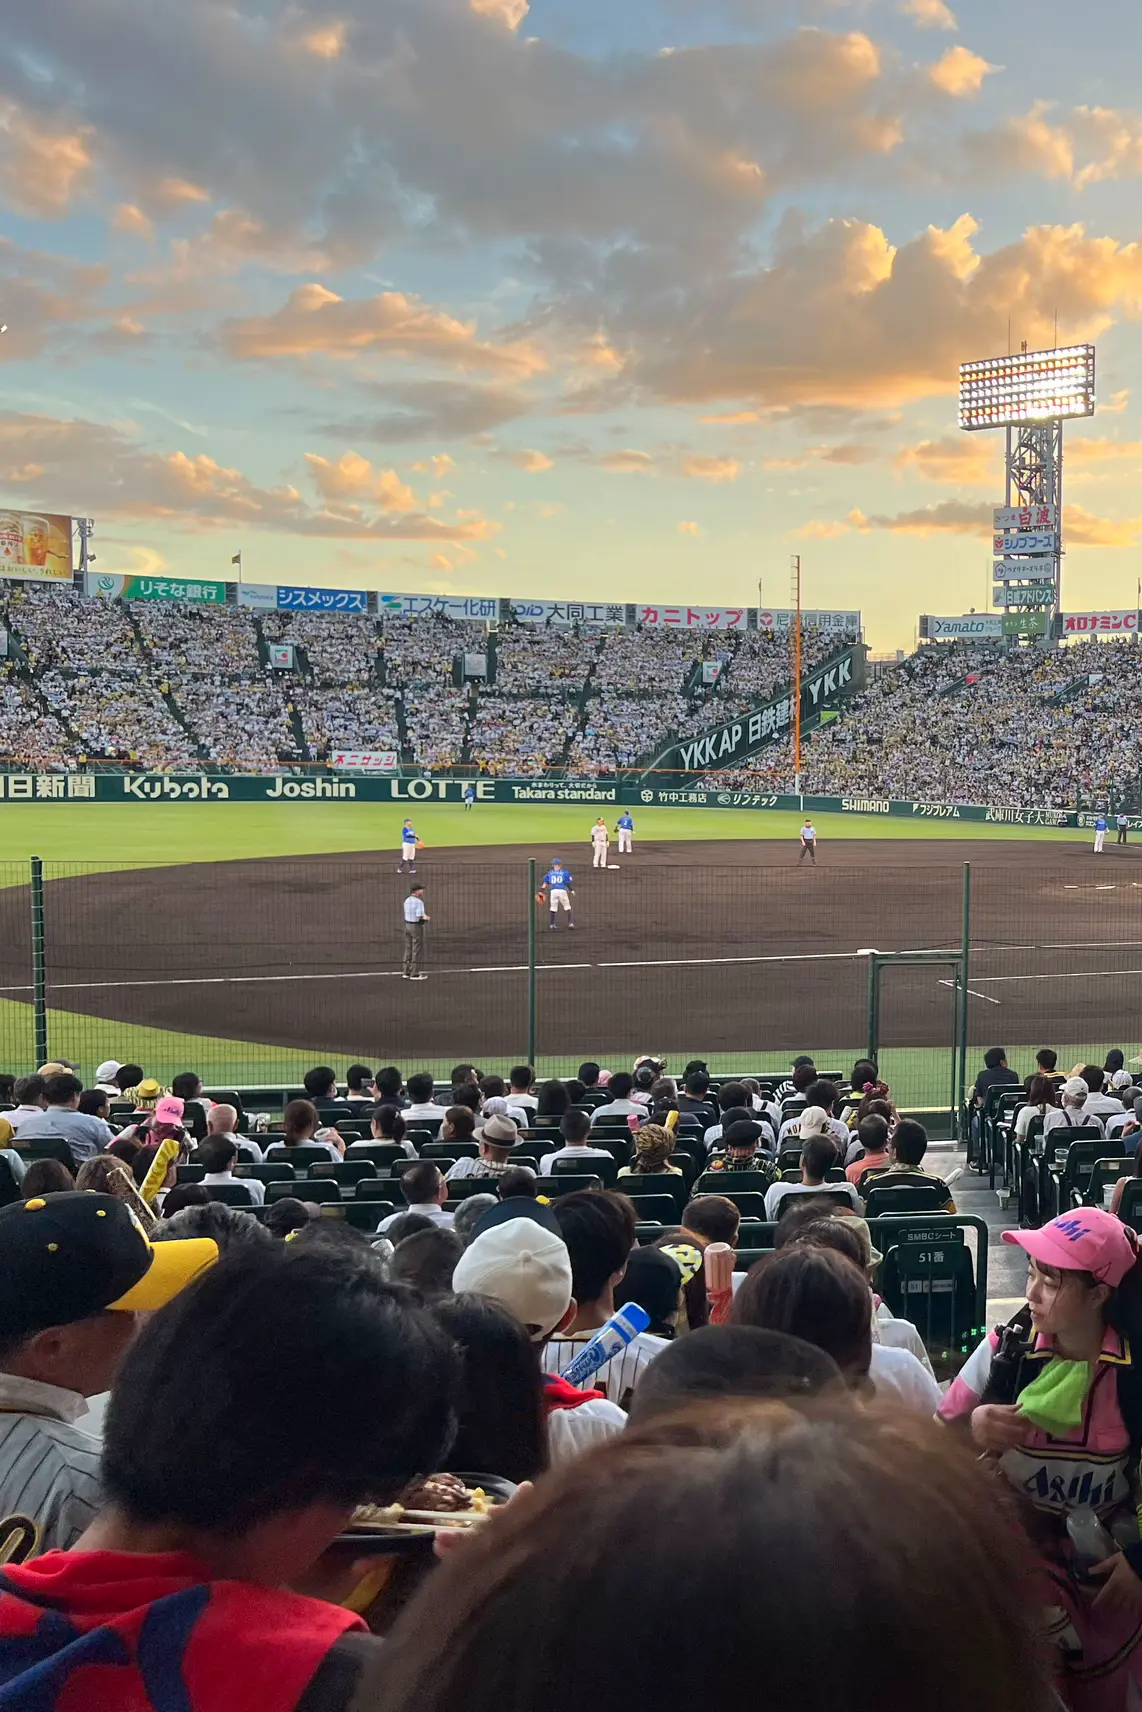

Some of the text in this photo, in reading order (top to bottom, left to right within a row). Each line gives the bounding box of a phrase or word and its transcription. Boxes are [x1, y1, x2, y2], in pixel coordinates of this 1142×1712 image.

[1004, 535, 1053, 549] シノブフーズ
[140, 580, 218, 600] りそな銀行
[278, 589, 364, 608] シスメックス
[402, 596, 497, 618] エスケー化研
[548, 603, 624, 623] 大同工業
[641, 606, 744, 628] カニトップ
[1064, 614, 1137, 631] オロナミンC
[934, 620, 985, 634] Yamato
[808, 657, 852, 704] YKK
[334, 753, 398, 767] 不二サッシ
[0, 775, 96, 799] 日新聞
[124, 776, 230, 799] Kubota
[265, 777, 356, 798] Joshin
[391, 779, 496, 799] LOTTE
[511, 786, 616, 801] Takara standard
[658, 791, 707, 803] 竹中工務店
[732, 793, 778, 807] リンテック
[841, 798, 890, 813] SHIMANO
[920, 803, 960, 818] フジプレアム
[907, 1232, 957, 1241] SMBCシート
[918, 1251, 945, 1263] 51番
